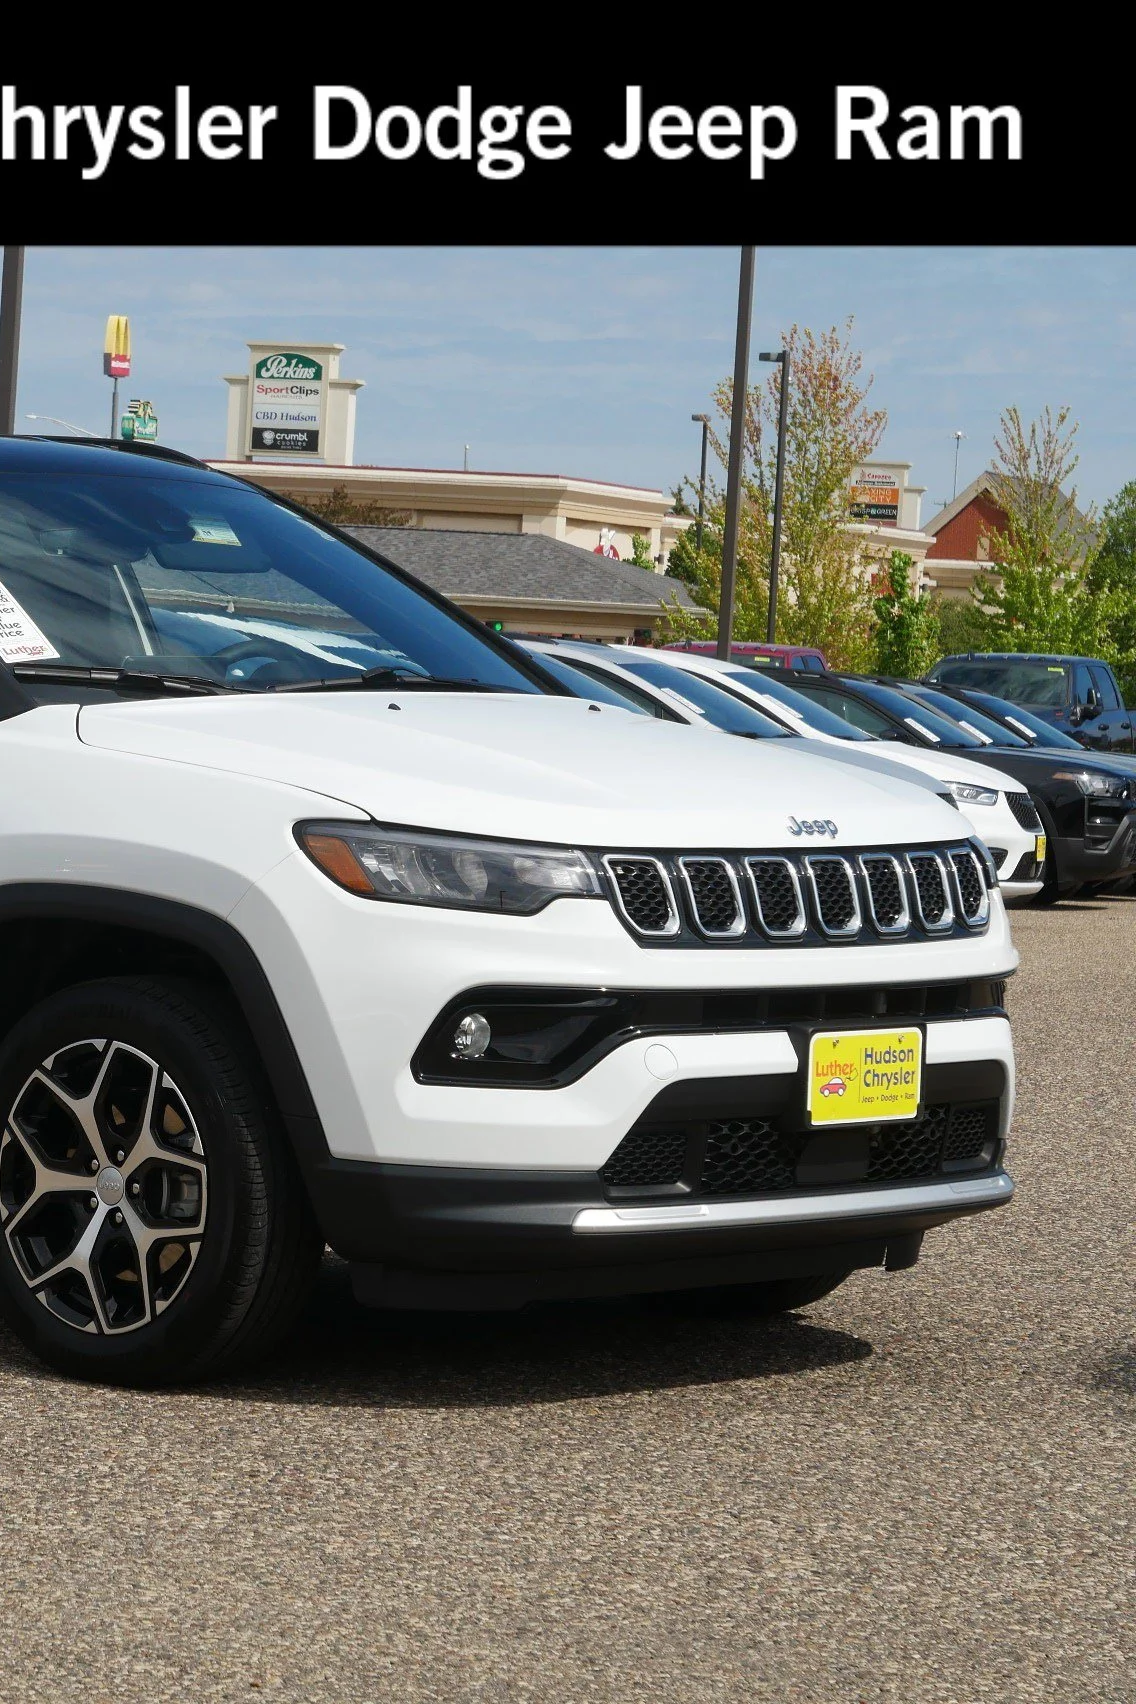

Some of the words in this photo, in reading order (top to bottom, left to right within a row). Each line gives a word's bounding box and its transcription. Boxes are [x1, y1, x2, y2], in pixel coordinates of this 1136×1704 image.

[260, 355, 316, 379] Perkins
[255, 411, 278, 420] CBD
[280, 411, 317, 422] Hudson
[275, 433, 308, 441] crumbl
[2, 645, 47, 656] Luther
[787, 815, 839, 840] Jeep
[864, 1046, 914, 1065] Hudson
[815, 1060, 855, 1078] Luther
[863, 1067, 916, 1090] Chrysler
[861, 1096, 875, 1104] Jeep
[880, 1094, 899, 1103] Dodge
[904, 1092, 916, 1100] Ram
